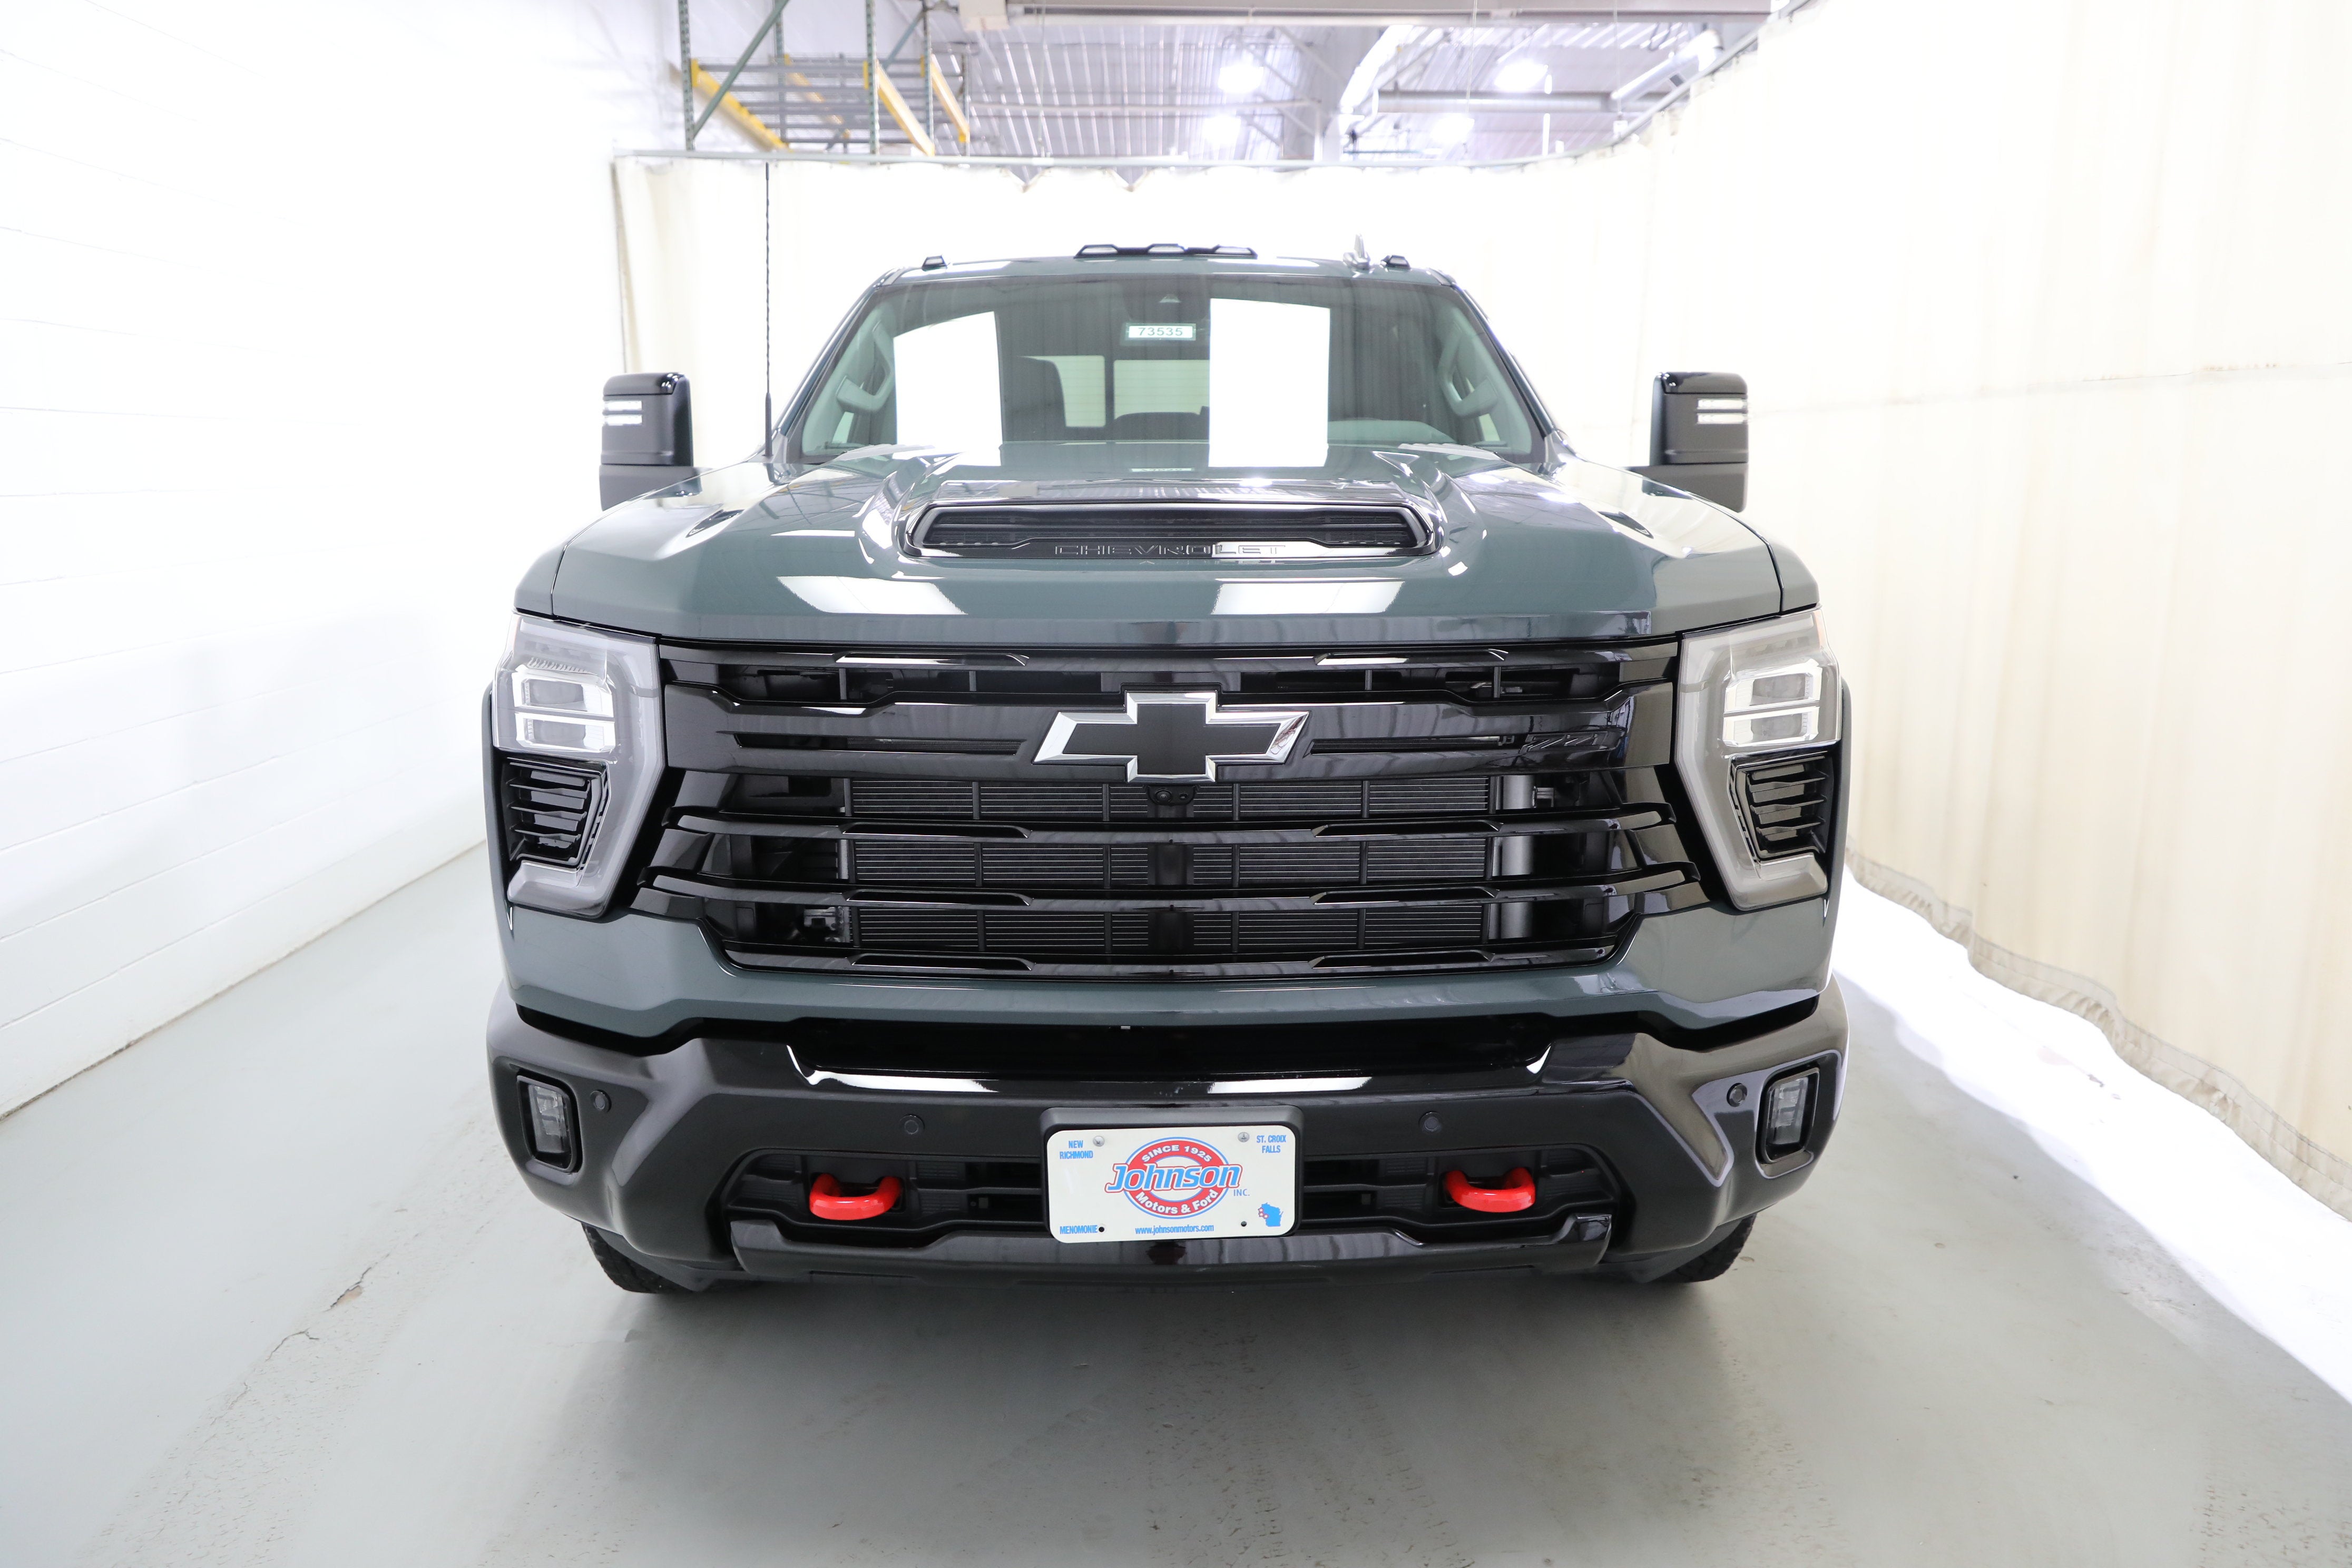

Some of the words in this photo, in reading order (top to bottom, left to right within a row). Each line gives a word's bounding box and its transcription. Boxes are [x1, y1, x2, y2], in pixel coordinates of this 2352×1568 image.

[1138, 327, 1183, 336] 73535
[1055, 545, 1286, 555] CHEVROLET
[1069, 1140, 1083, 1149] NEW
[1262, 1145, 1281, 1153] FALLS
[1060, 1150, 1093, 1159] RICHMOND
[1142, 1144, 1180, 1162] SINCE
[1184, 1145, 1212, 1162] 1925
[1106, 1164, 1241, 1192] Johnson
[1135, 1191, 1178, 1214] Motors
[1181, 1204, 1191, 1213] &
[1192, 1189, 1218, 1210] Ford
[1060, 1225, 1098, 1234] MENOMONIE
[1135, 1224, 1214, 1235] www.johnsonmotors.com
